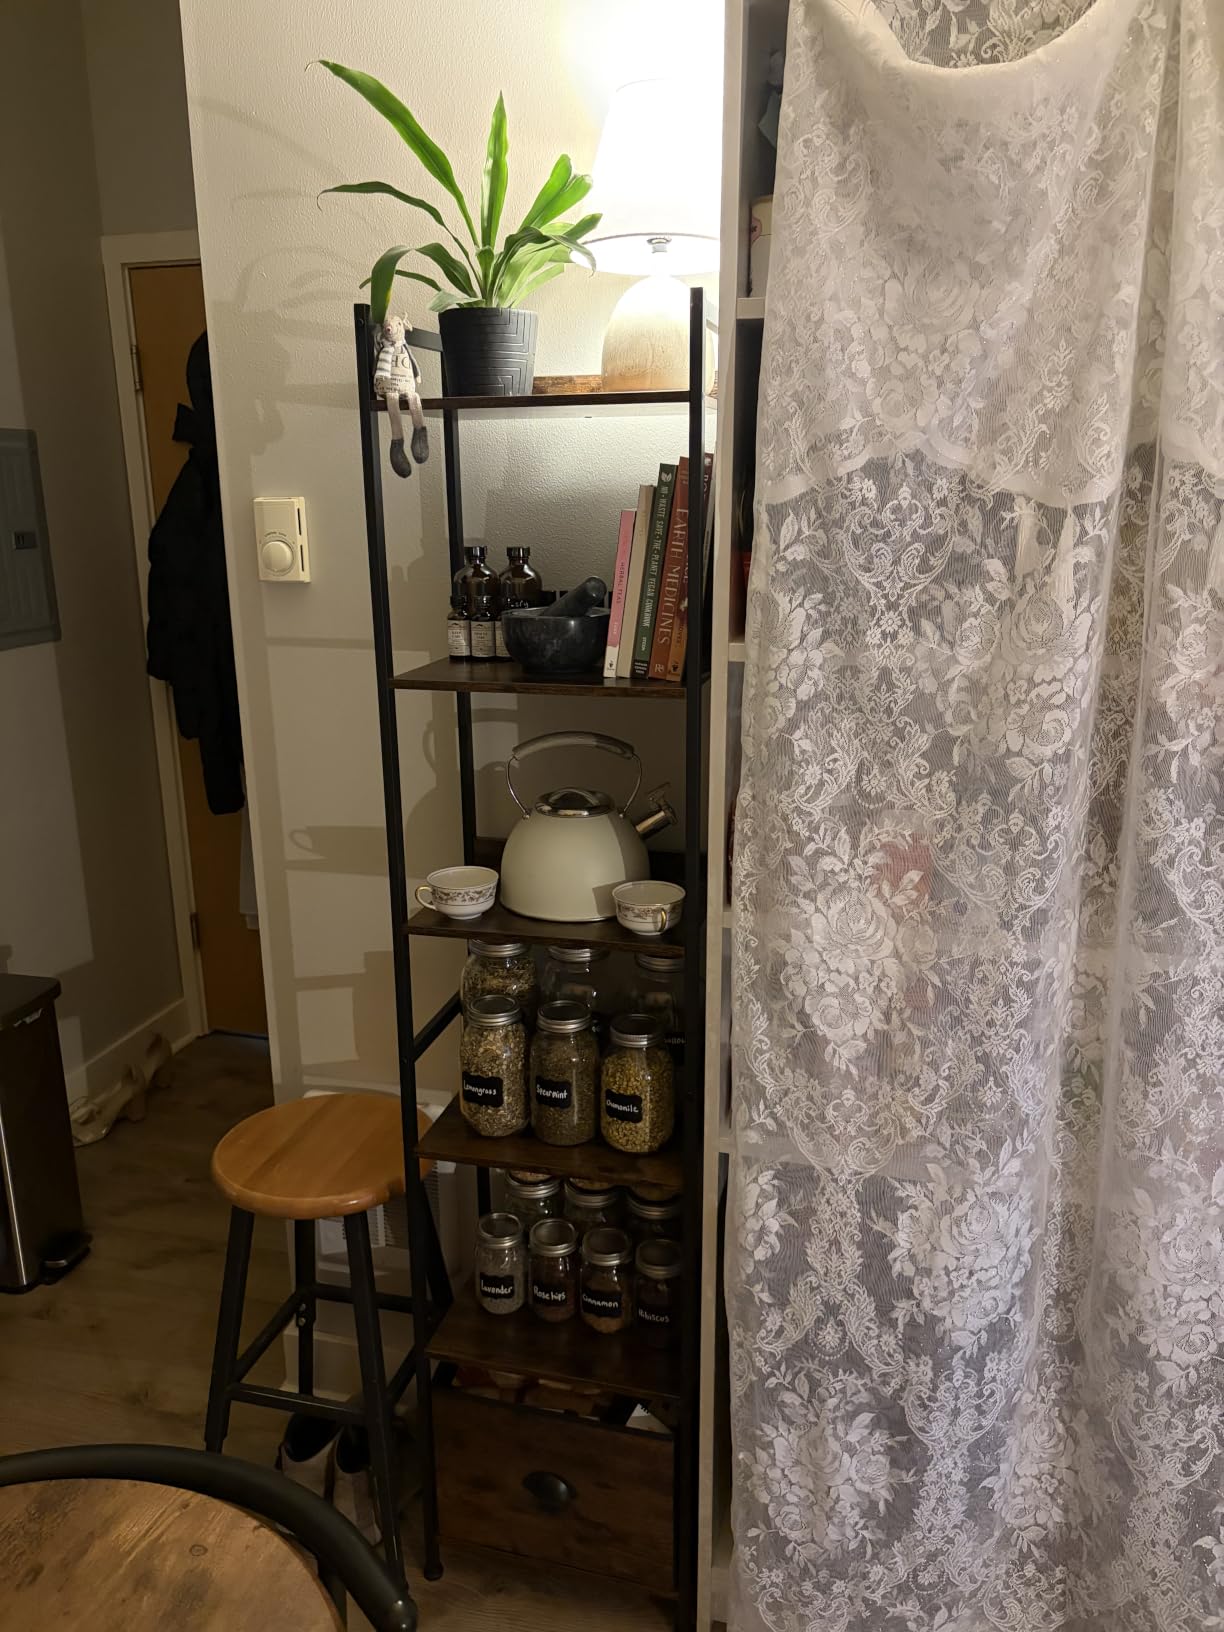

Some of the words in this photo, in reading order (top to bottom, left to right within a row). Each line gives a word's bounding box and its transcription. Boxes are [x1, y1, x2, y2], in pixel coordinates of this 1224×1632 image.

[671, 508, 689, 559] EARTH
[617, 562, 625, 586] HERBAL
[646, 578, 656, 597] VEGAN
[615, 589, 623, 604] TEAS
[658, 565, 681, 645] MEDICINES
[642, 599, 654, 628] COOKBOOK
[463, 1079, 497, 1096] Lemongrass
[536, 1084, 569, 1099] Spearmint
[481, 1279, 513, 1294] Lavender
[582, 1293, 619, 1308] Cinnamon
[638, 1307, 670, 1323] Hibiscus
